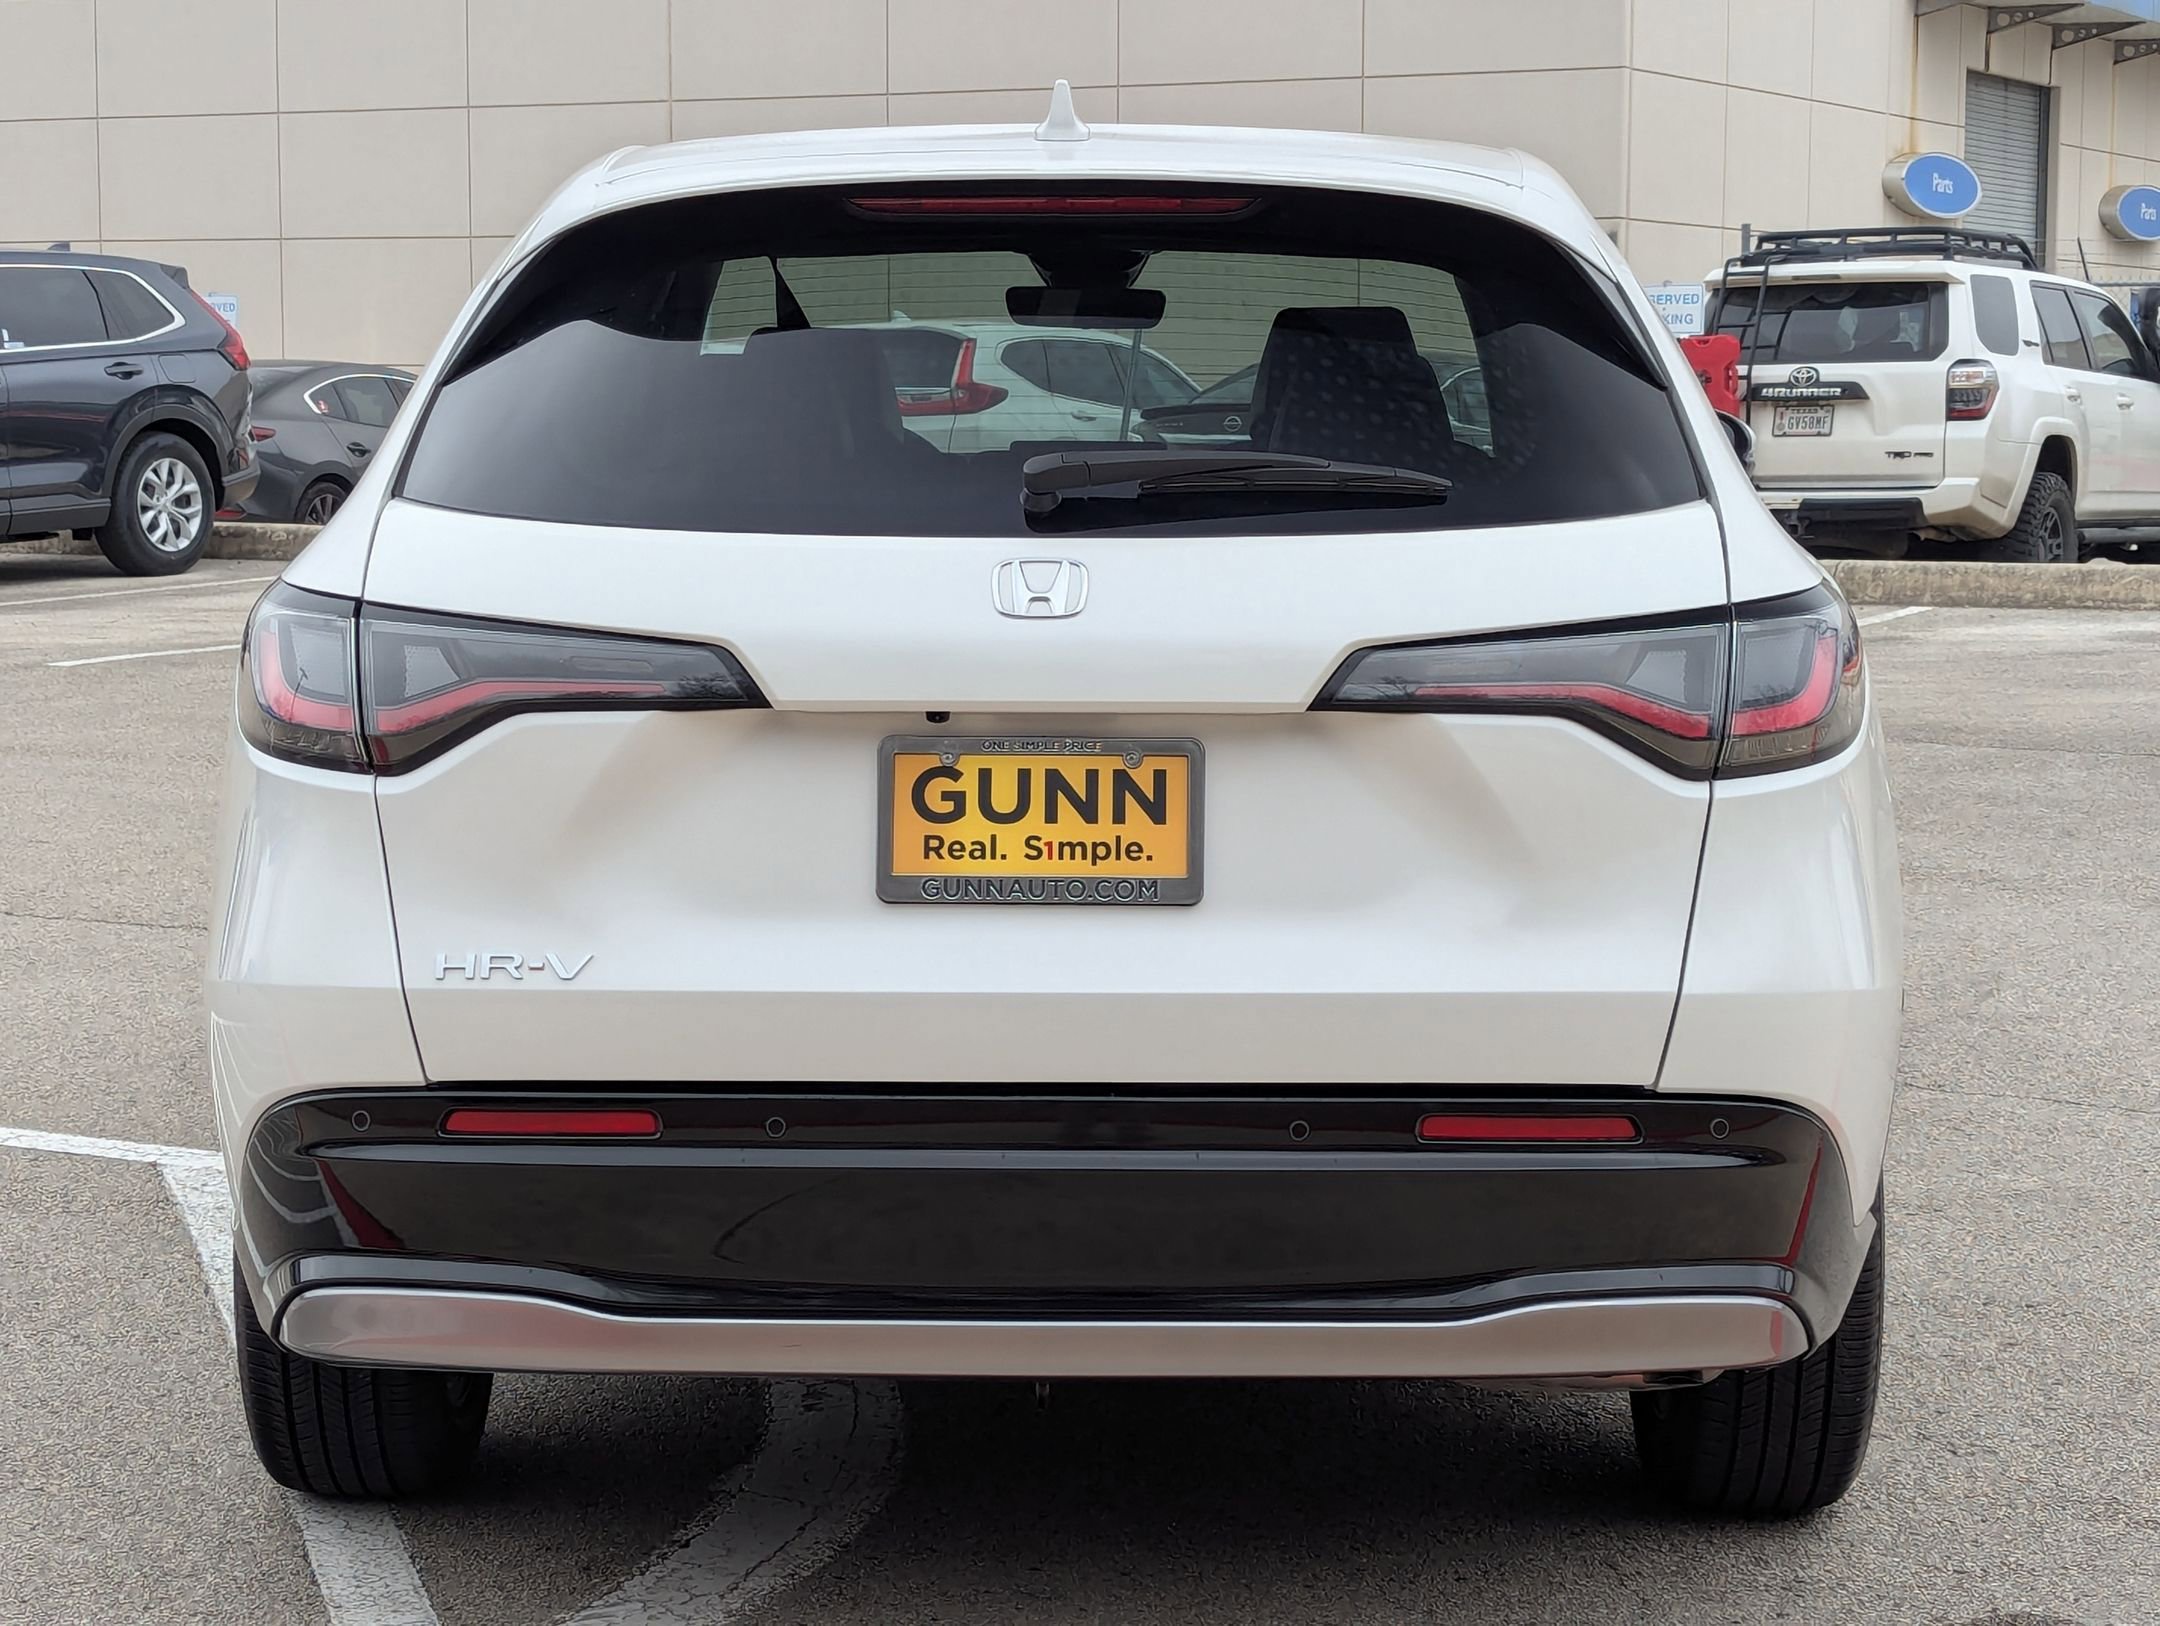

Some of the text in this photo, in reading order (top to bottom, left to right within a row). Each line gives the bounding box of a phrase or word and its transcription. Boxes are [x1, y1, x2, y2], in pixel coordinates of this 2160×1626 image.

[1932, 172, 1954, 194] Parts
[1760, 387, 1842, 398] 4RUNNER
[981, 739, 1103, 753] ONE SIMPLE PRICE
[910, 765, 1167, 825] GUNN
[922, 834, 1007, 861] Real.
[920, 877, 1160, 901] GUNNAUTO.COM
[434, 952, 595, 981] HR-V
